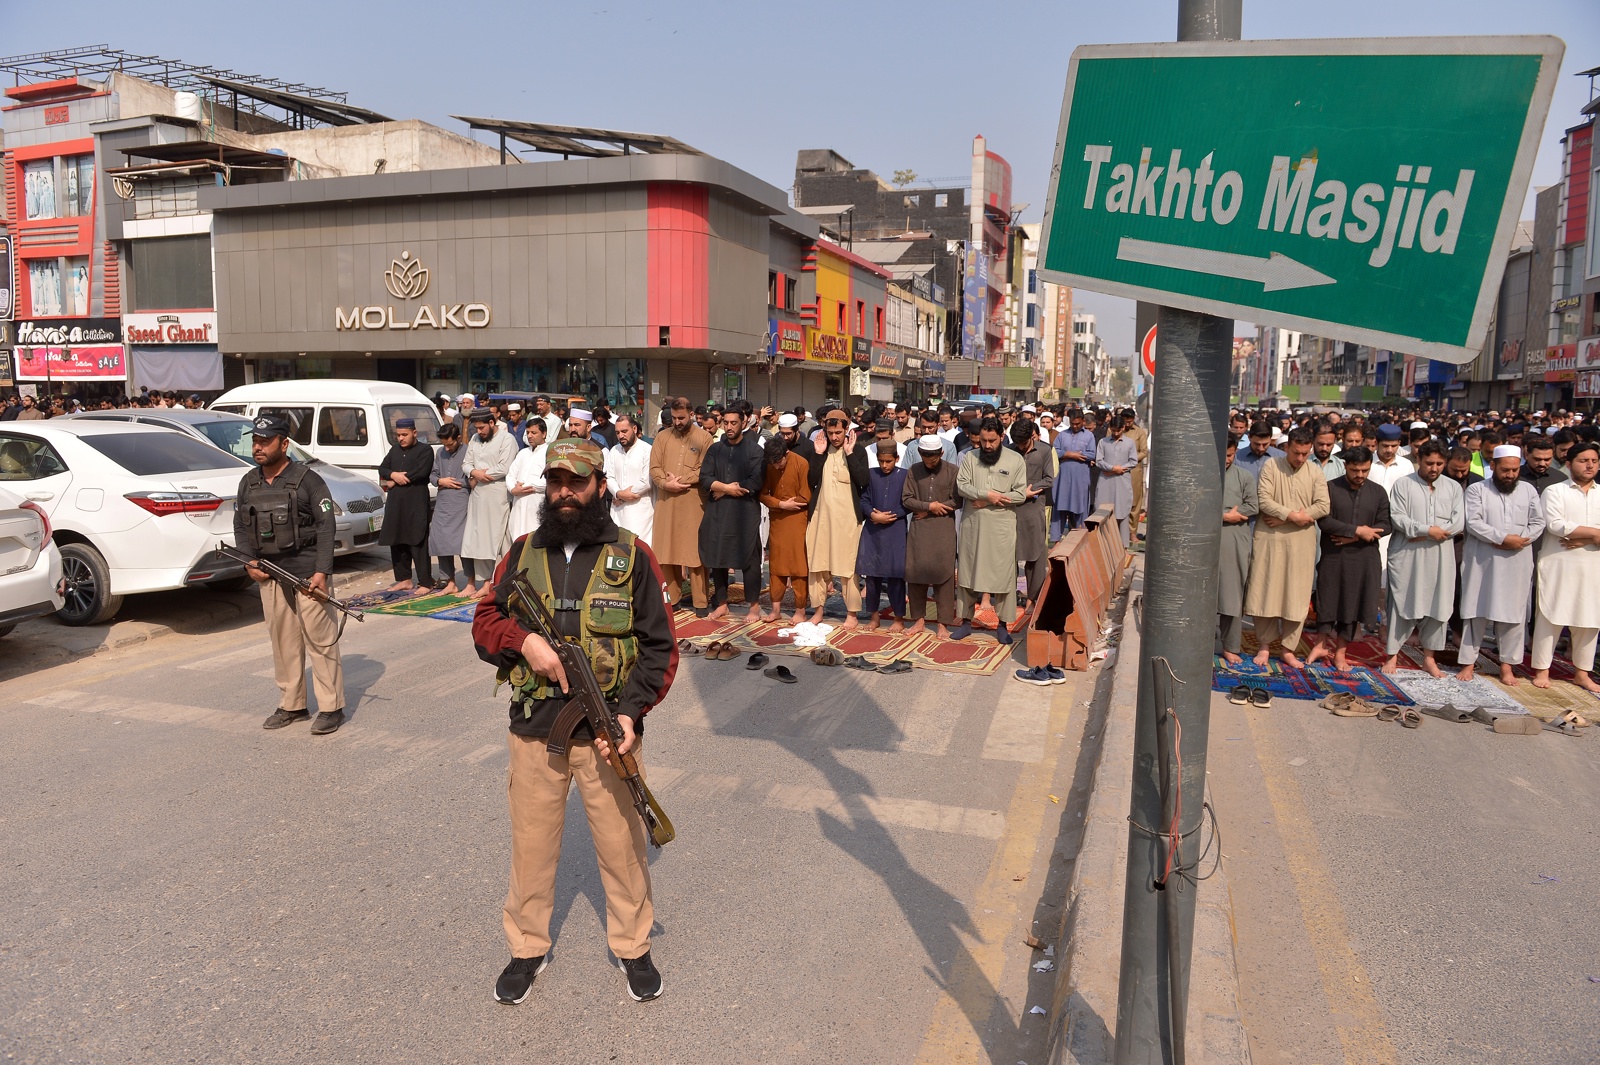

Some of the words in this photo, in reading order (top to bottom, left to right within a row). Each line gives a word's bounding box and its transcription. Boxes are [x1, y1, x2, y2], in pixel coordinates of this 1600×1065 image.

[1083, 144, 1243, 225] Takhto
[1257, 154, 1475, 268] Masjid
[335, 303, 490, 330] MOLAKO
[127, 324, 165, 342] Saeed
[167, 323, 209, 342] Ghani
[813, 332, 848, 355] LONDON
[1056, 320, 1065, 377] JEWELLERS
[98, 356, 119, 369] SALE
[1546, 357, 1576, 371] MUBARAK
